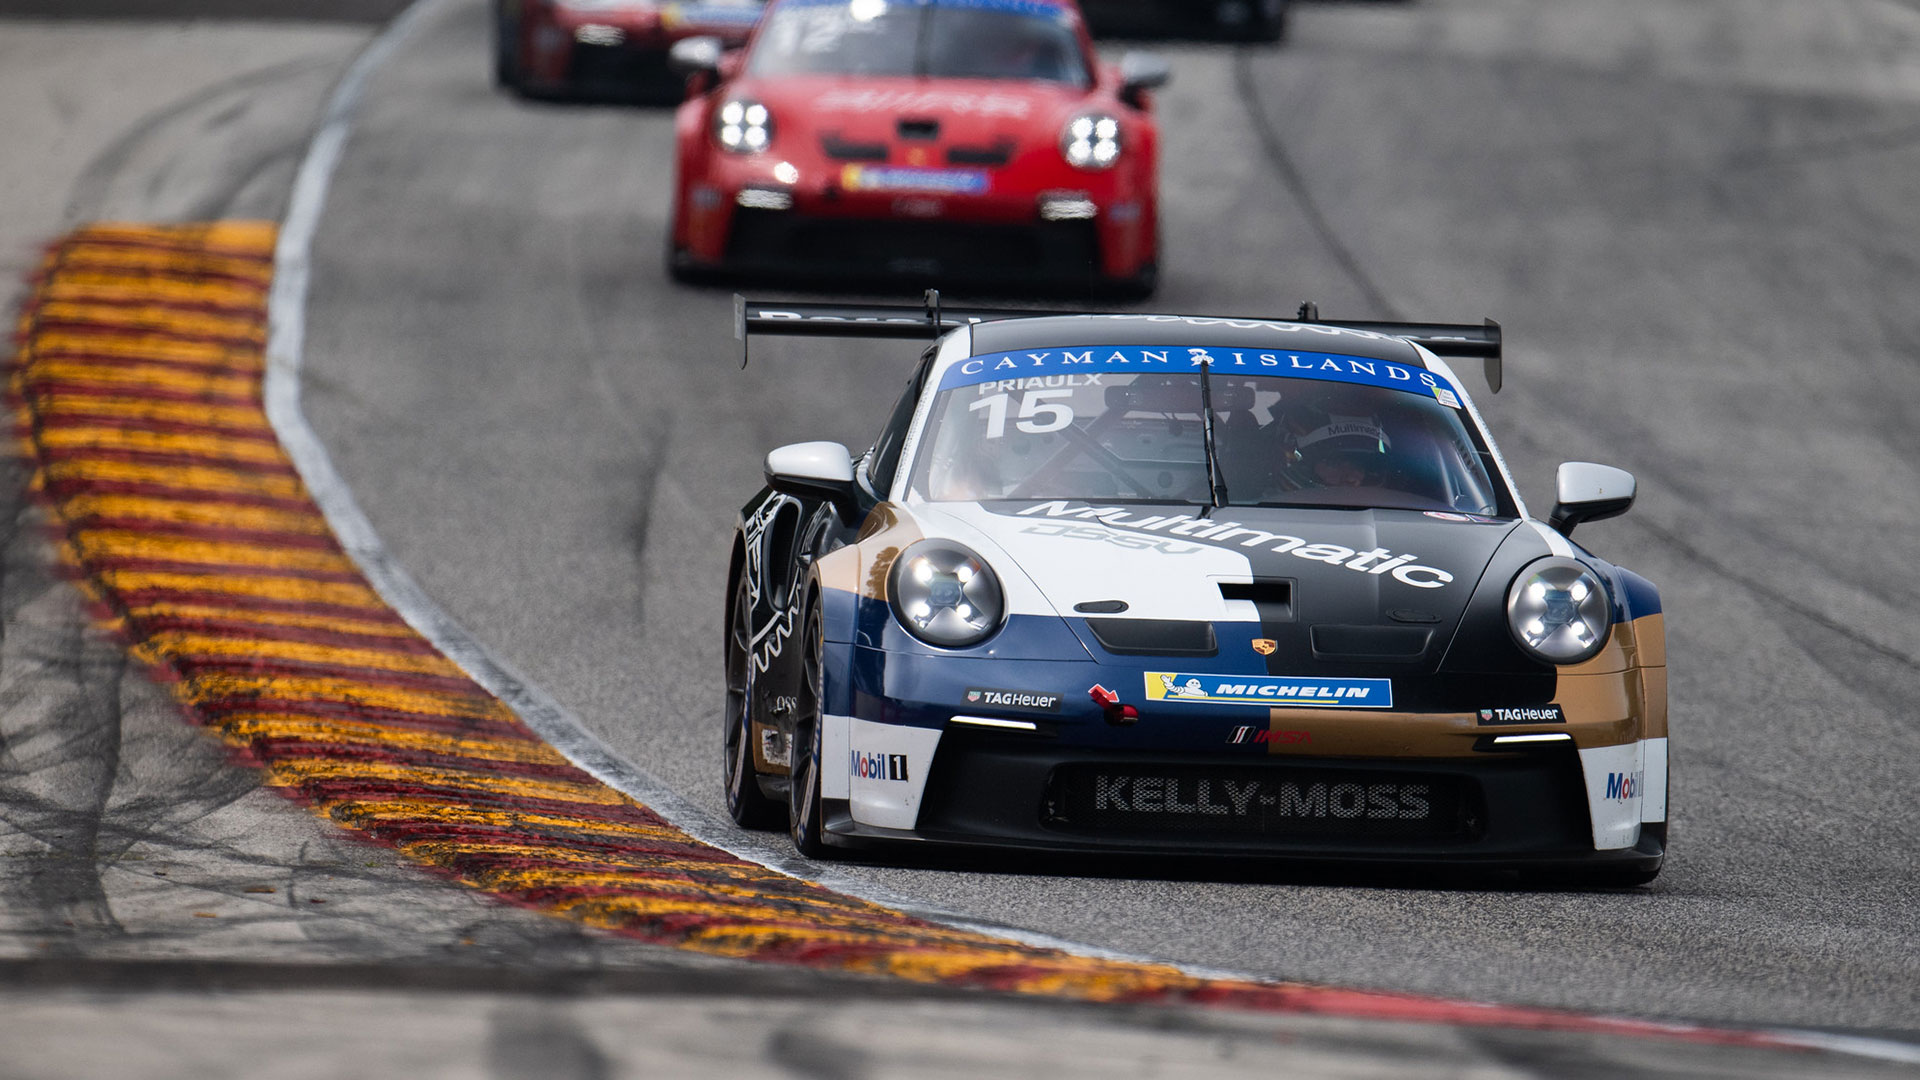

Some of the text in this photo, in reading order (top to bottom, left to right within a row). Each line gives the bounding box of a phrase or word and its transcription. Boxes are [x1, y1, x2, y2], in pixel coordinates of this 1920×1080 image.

[960, 350, 1438, 387] CAYMAN ISLANDS
[978, 373, 1103, 395] PRIAULX
[968, 388, 1074, 440] 15
[1016, 500, 1454, 588] Multimatic
[1215, 683, 1371, 698] MICHELIN
[1253, 729, 1312, 744] IMSA
[851, 750, 903, 780] Mobil 1
[1095, 775, 1430, 819] KELLY-MOSS
